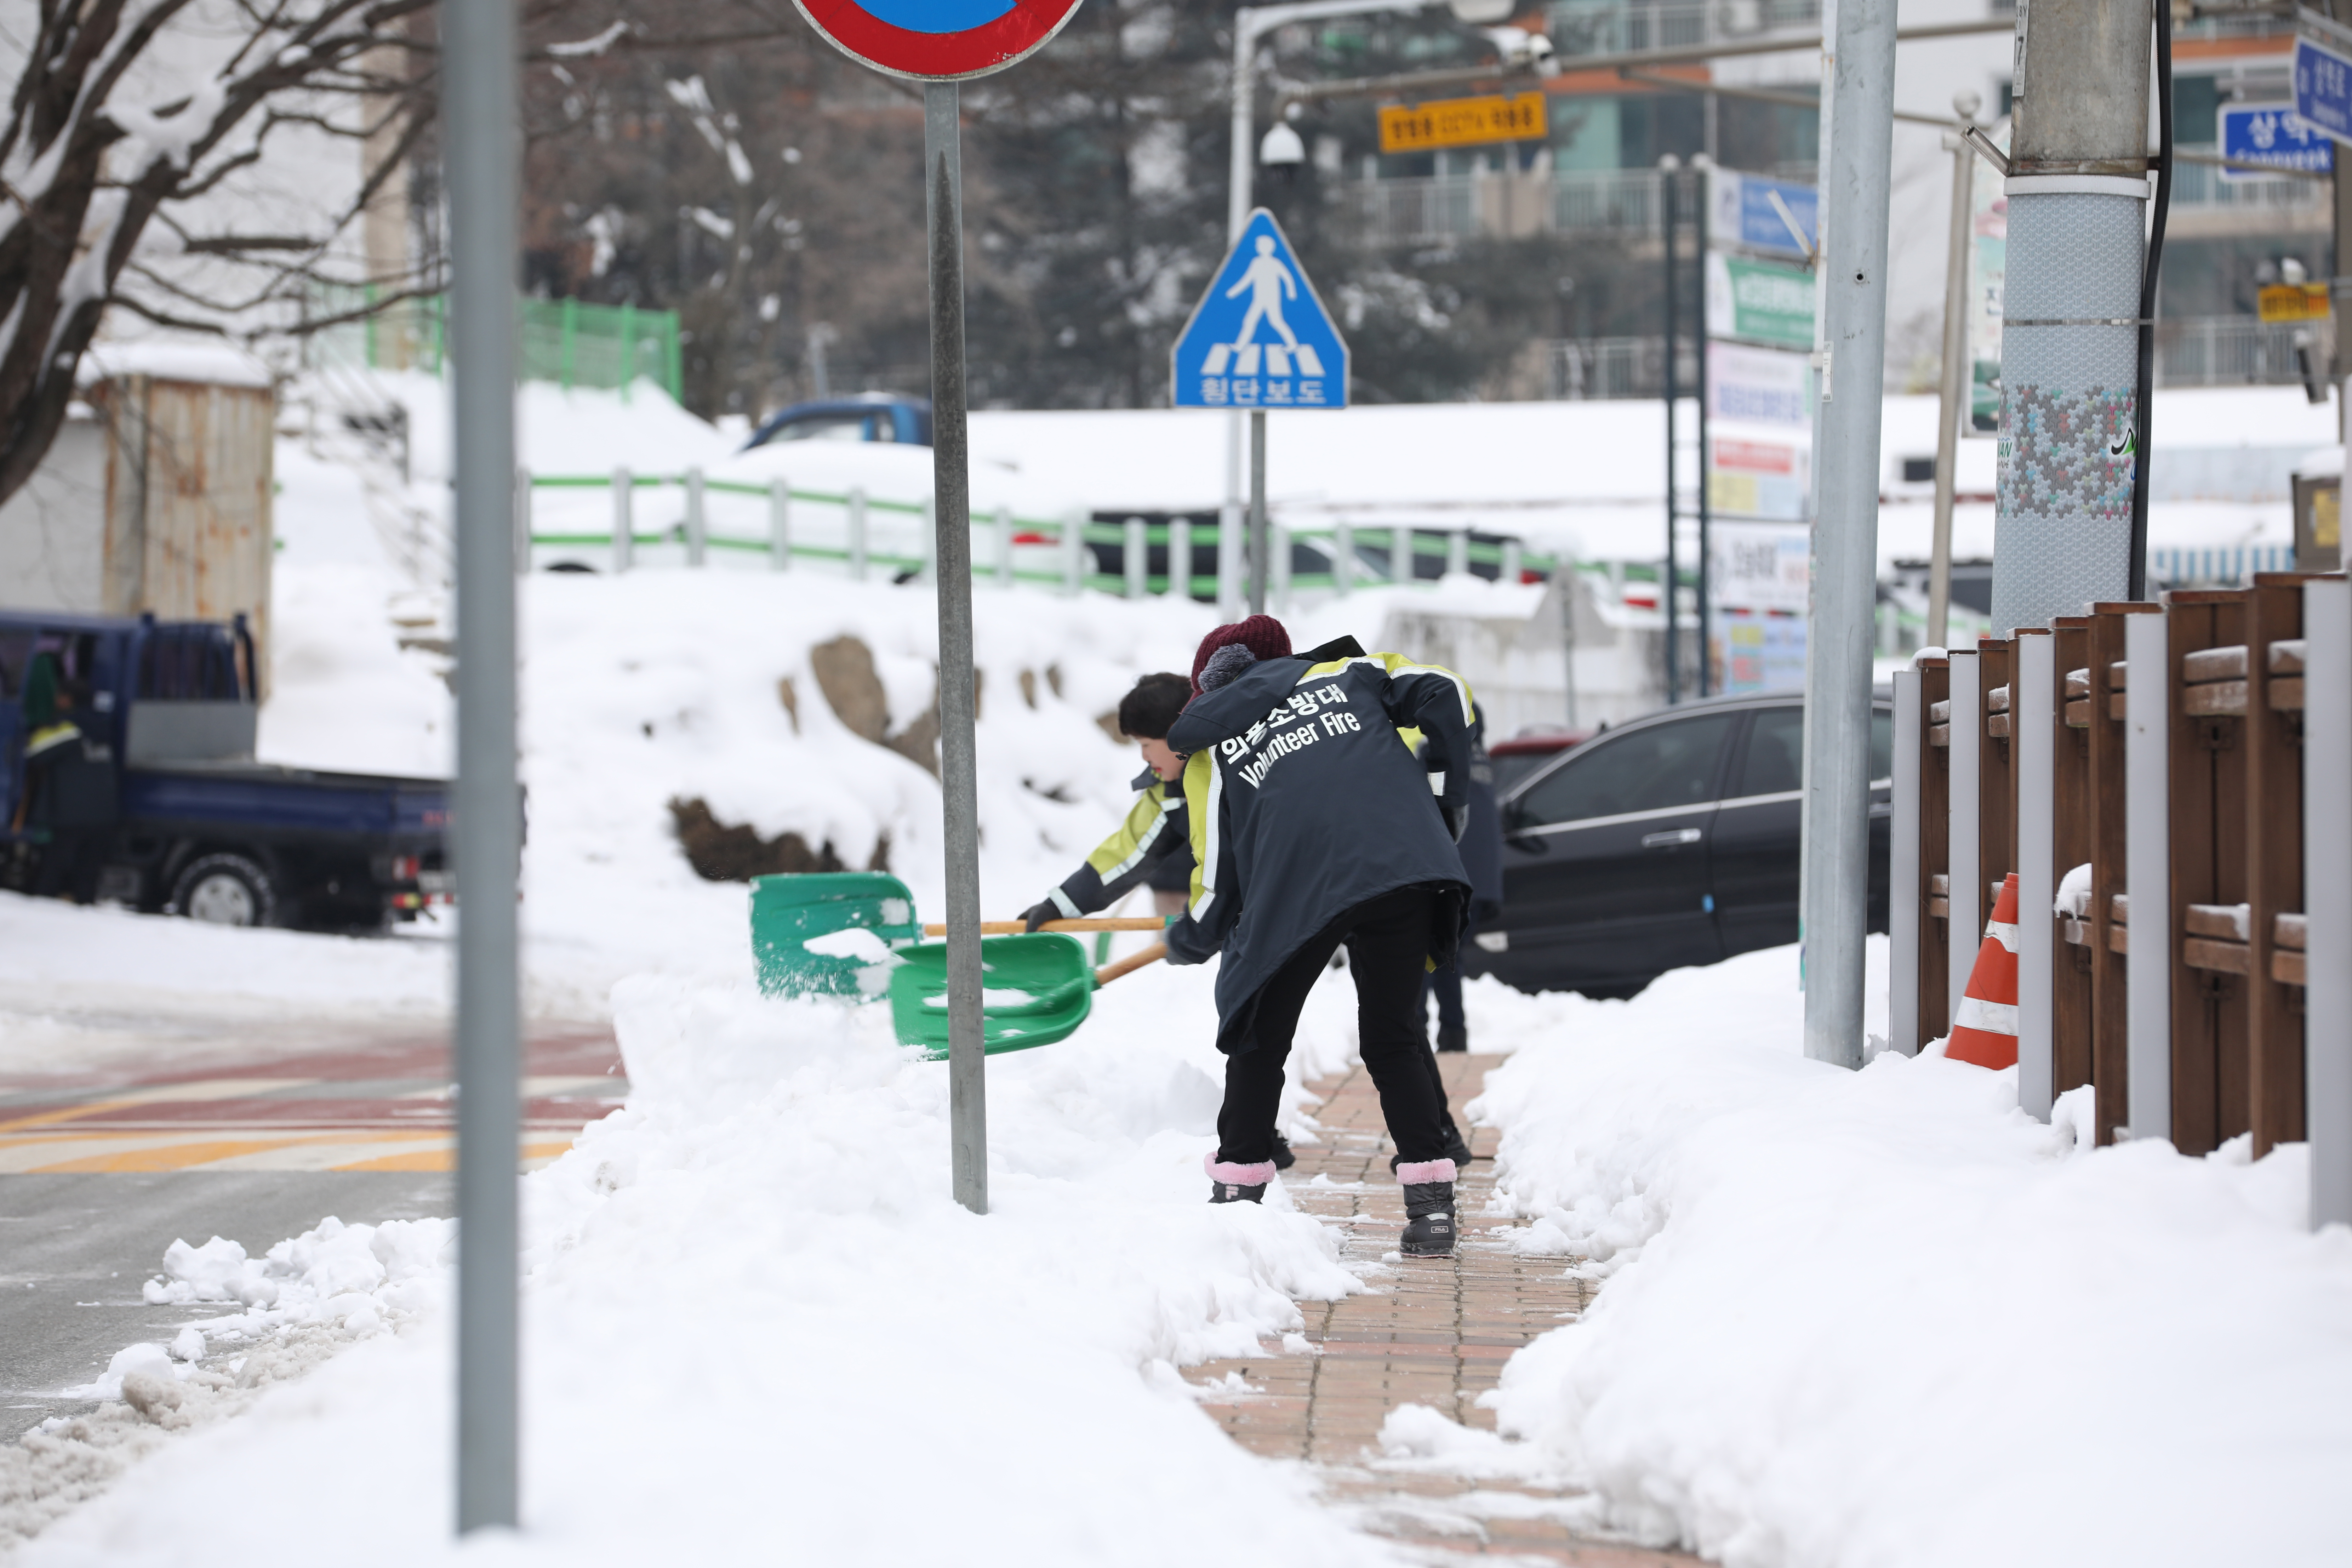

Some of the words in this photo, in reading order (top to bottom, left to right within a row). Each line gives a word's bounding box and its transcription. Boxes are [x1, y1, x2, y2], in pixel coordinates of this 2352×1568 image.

[1200, 378, 1327, 405] 횡단보도
[1221, 683, 1348, 765] 의용소방대
[1238, 722, 1320, 789] Volunteer
[1319, 711, 1361, 736] Fire
